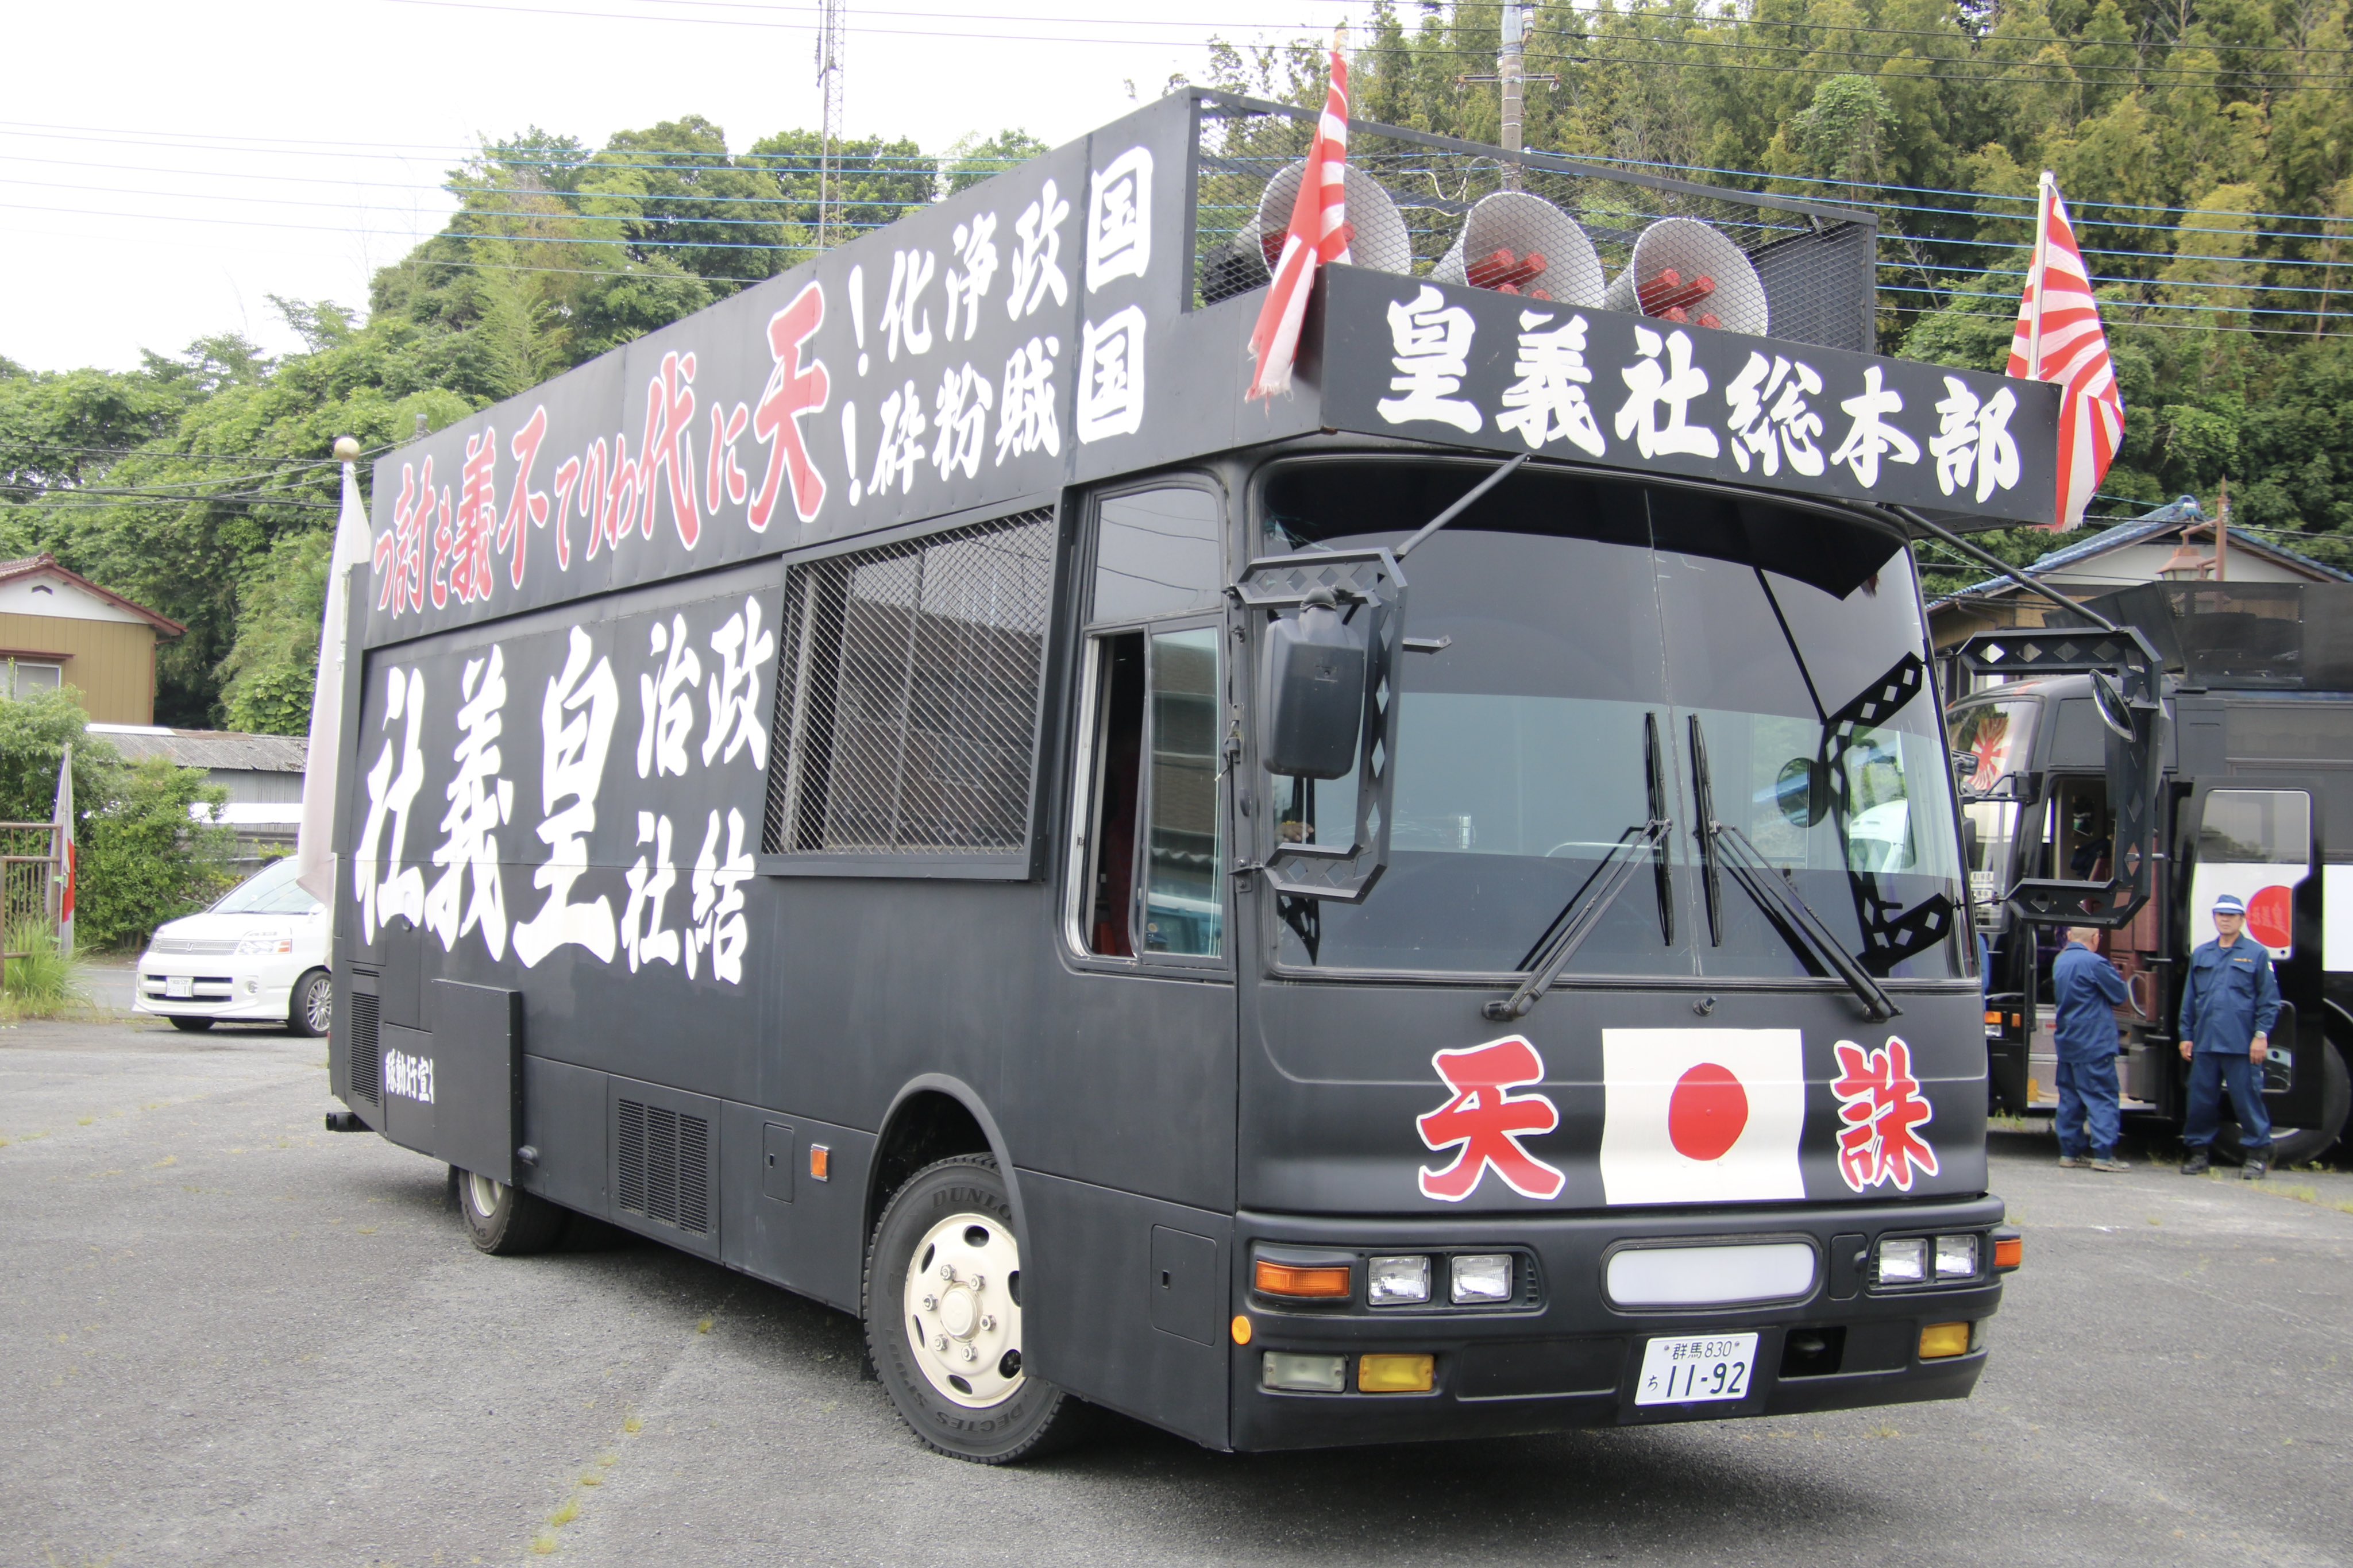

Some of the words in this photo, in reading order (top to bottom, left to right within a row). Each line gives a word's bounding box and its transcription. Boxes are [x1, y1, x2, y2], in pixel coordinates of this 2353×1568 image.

[1376, 285, 2020, 503] 皇義社総本部
[932, 1186, 1012, 1222] DUNLO
[1666, 1361, 1745, 1397] 11-92
[935, 1402, 1025, 1434] DECTES
